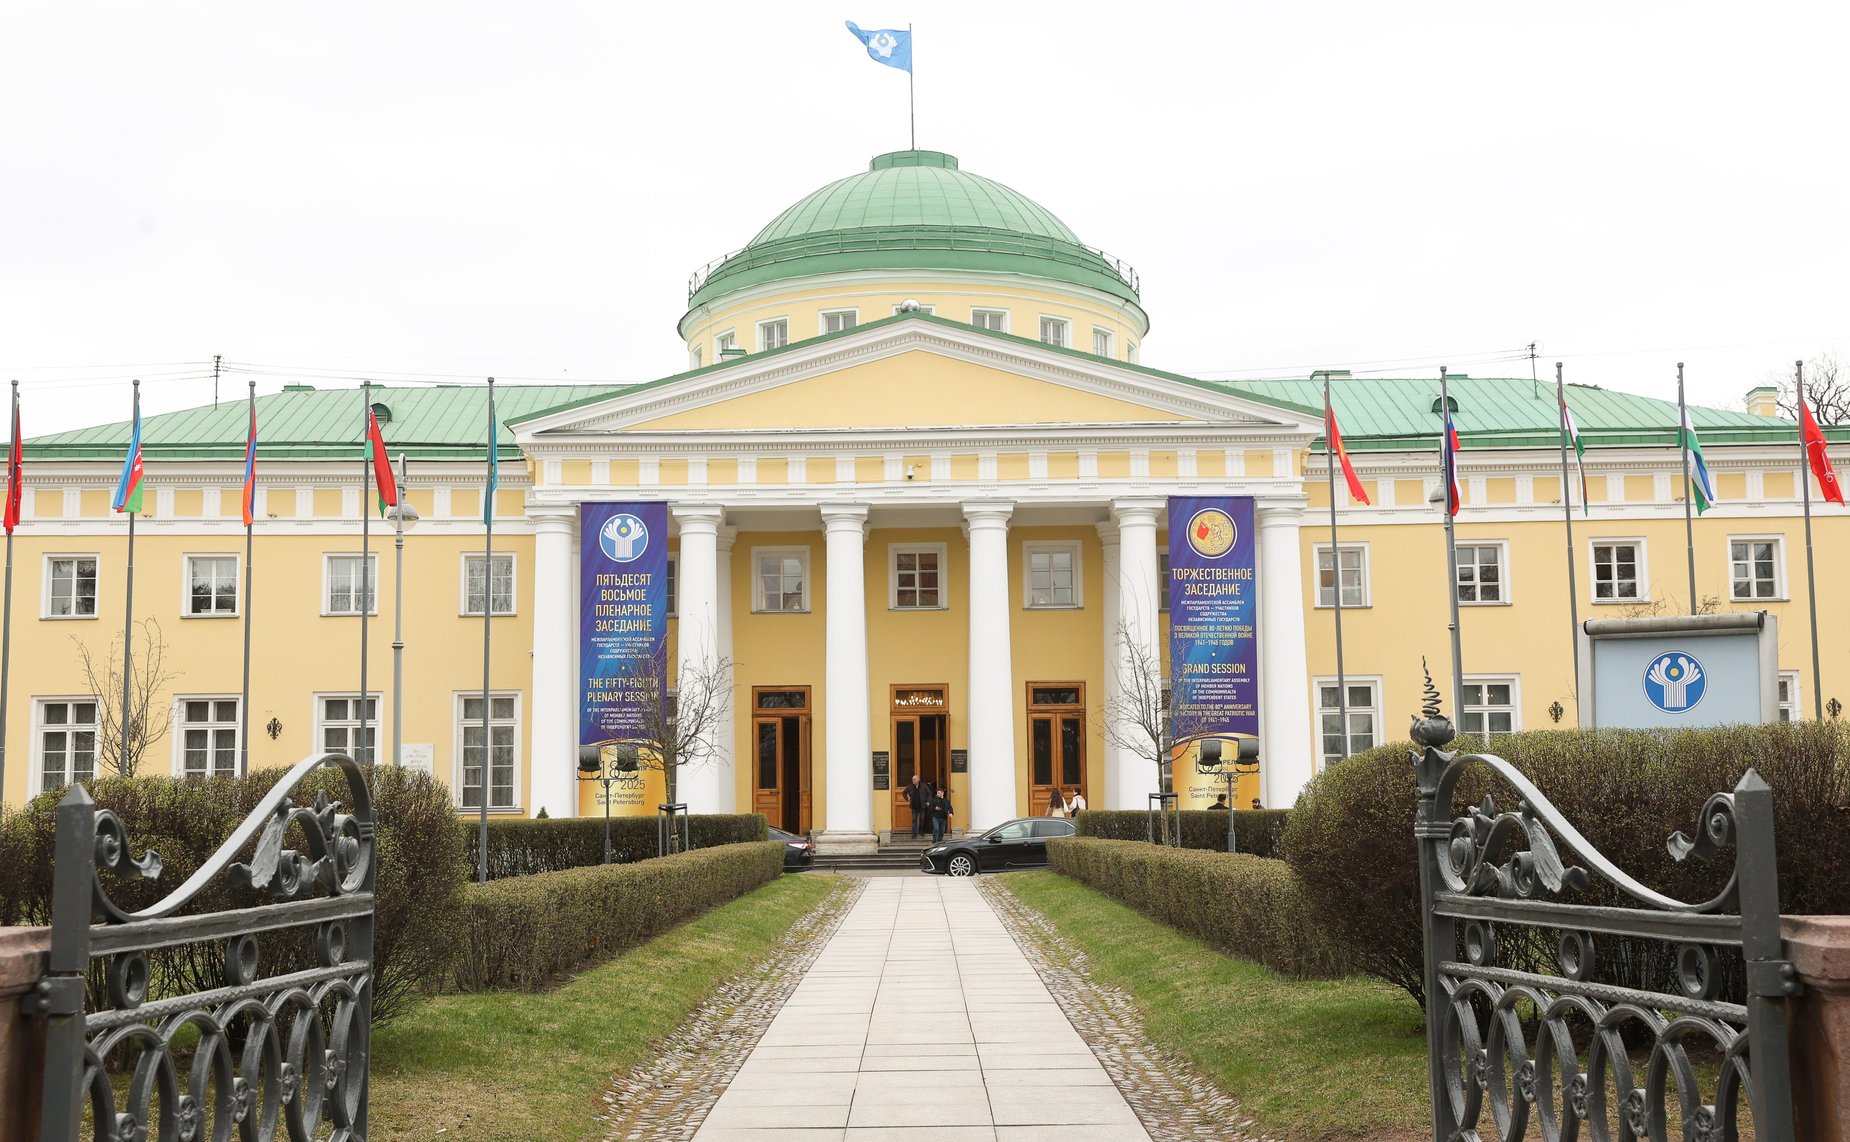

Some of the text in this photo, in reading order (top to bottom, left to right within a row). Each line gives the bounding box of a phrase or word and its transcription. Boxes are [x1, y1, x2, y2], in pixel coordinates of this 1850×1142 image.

[1172, 568, 1252, 580] ТОРЖЕСТВЕННОЕ
[596, 574, 652, 587] ПЯТЬДЕСЯТ
[602, 589, 646, 601] ВОСЬМОЕ
[1185, 584, 1240, 596] ЗАСЕДАНИЕ
[596, 604, 652, 616] ПЛЕНАРНОЕ
[596, 620, 652, 633] ЗАСЕДАНИЕ
[1183, 664, 1246, 673] GRAND SESSION
[588, 678, 603, 688] THE
[587, 692, 623, 702] PLENARY
[1214, 773, 1238, 783] 205
[621, 780, 645, 789] 2025
